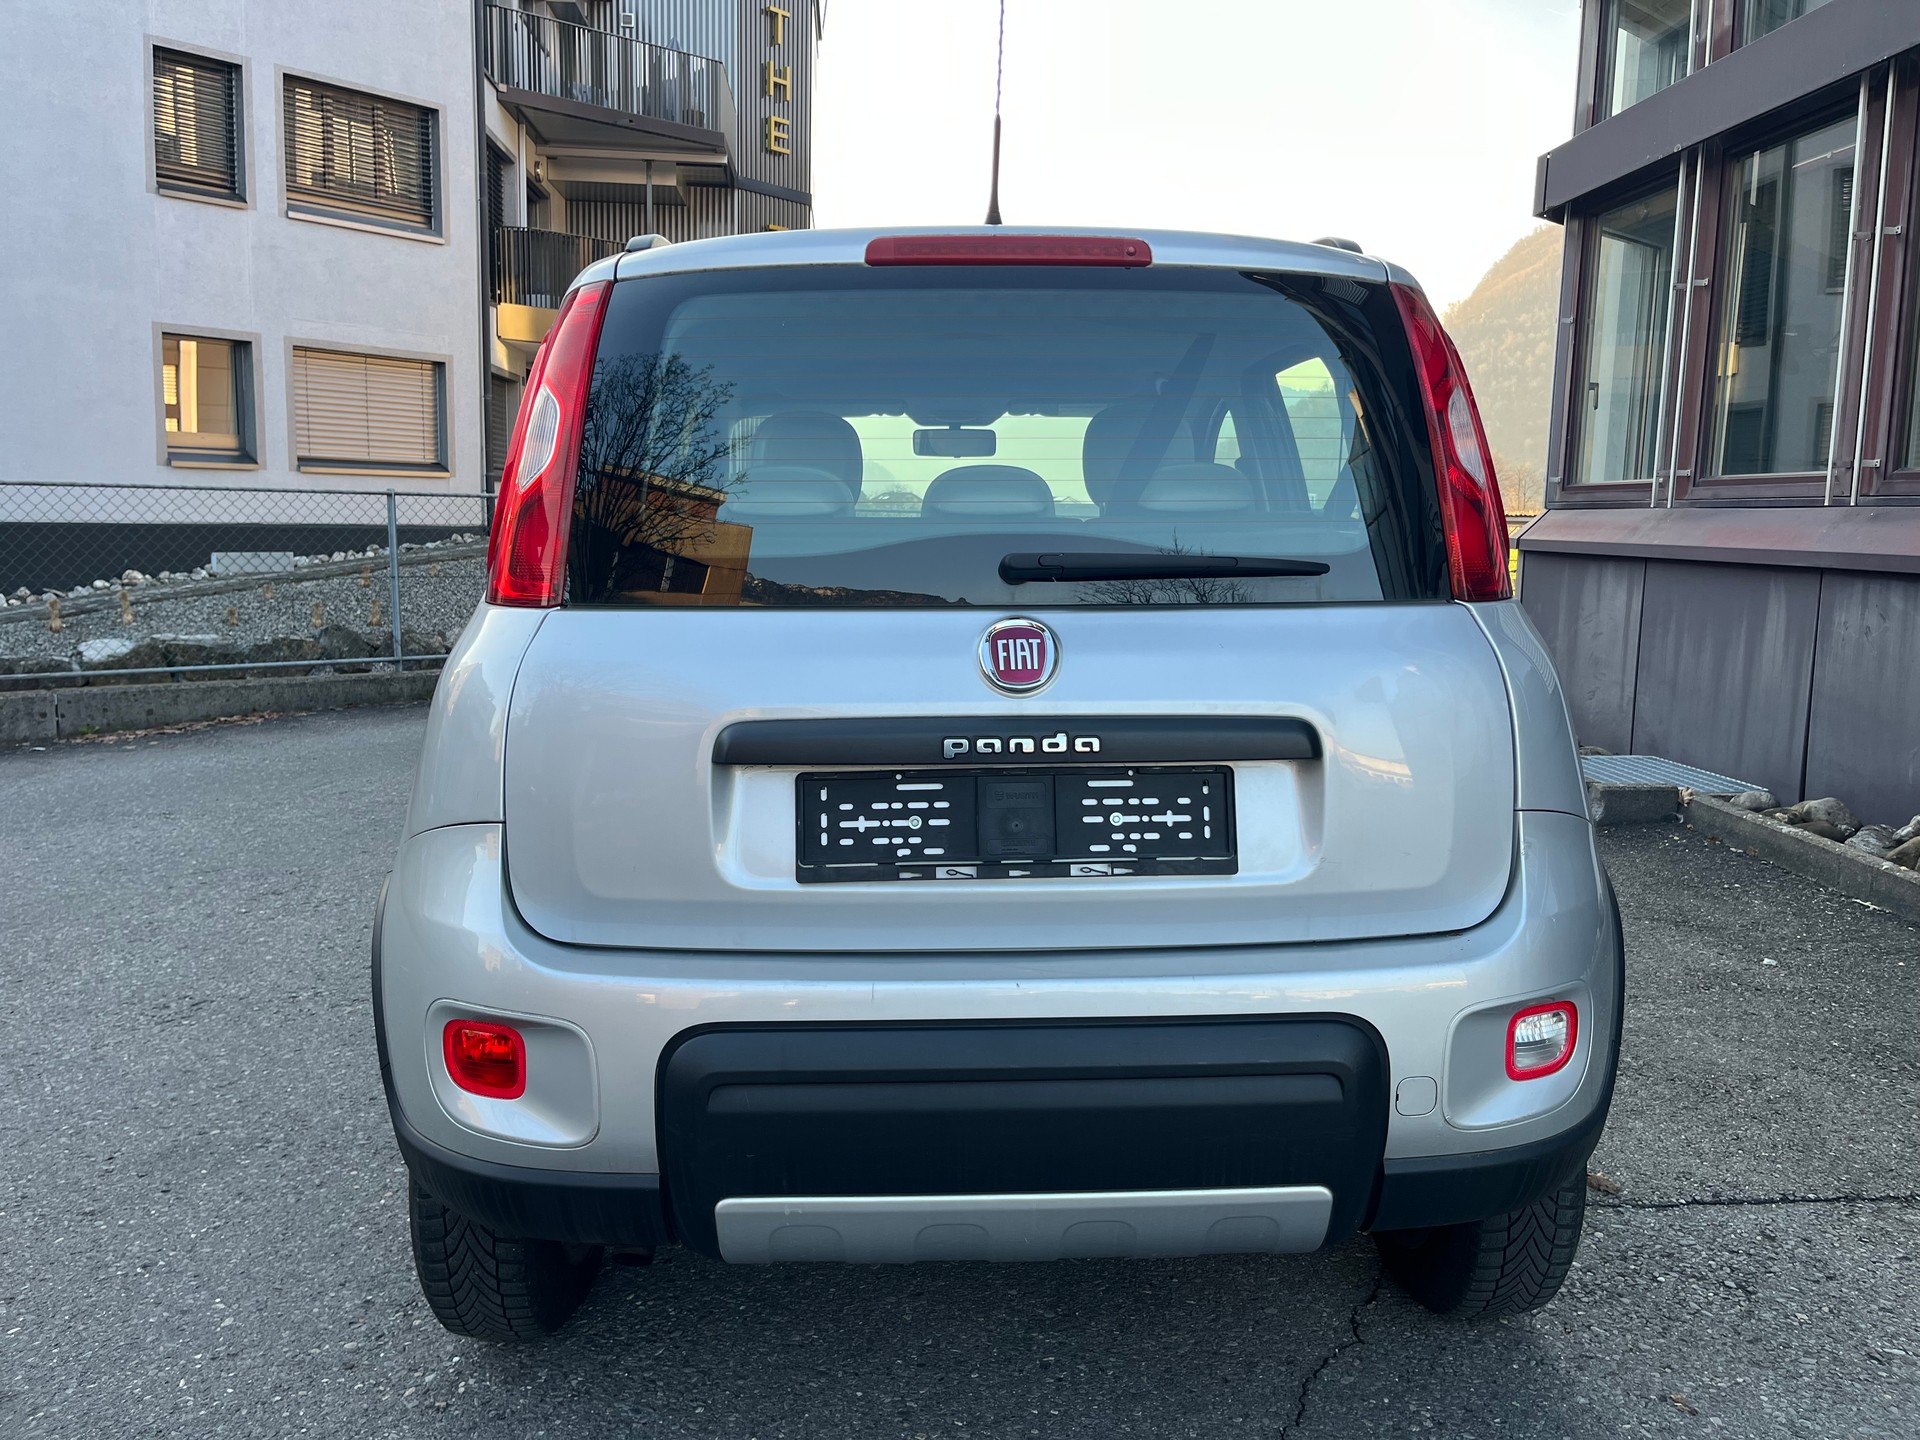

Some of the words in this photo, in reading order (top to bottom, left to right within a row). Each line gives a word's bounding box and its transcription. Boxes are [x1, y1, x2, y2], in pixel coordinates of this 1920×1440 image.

[766, 5, 791, 155] THE
[996, 638, 1041, 671] FIAT
[943, 732, 1101, 759] panda
